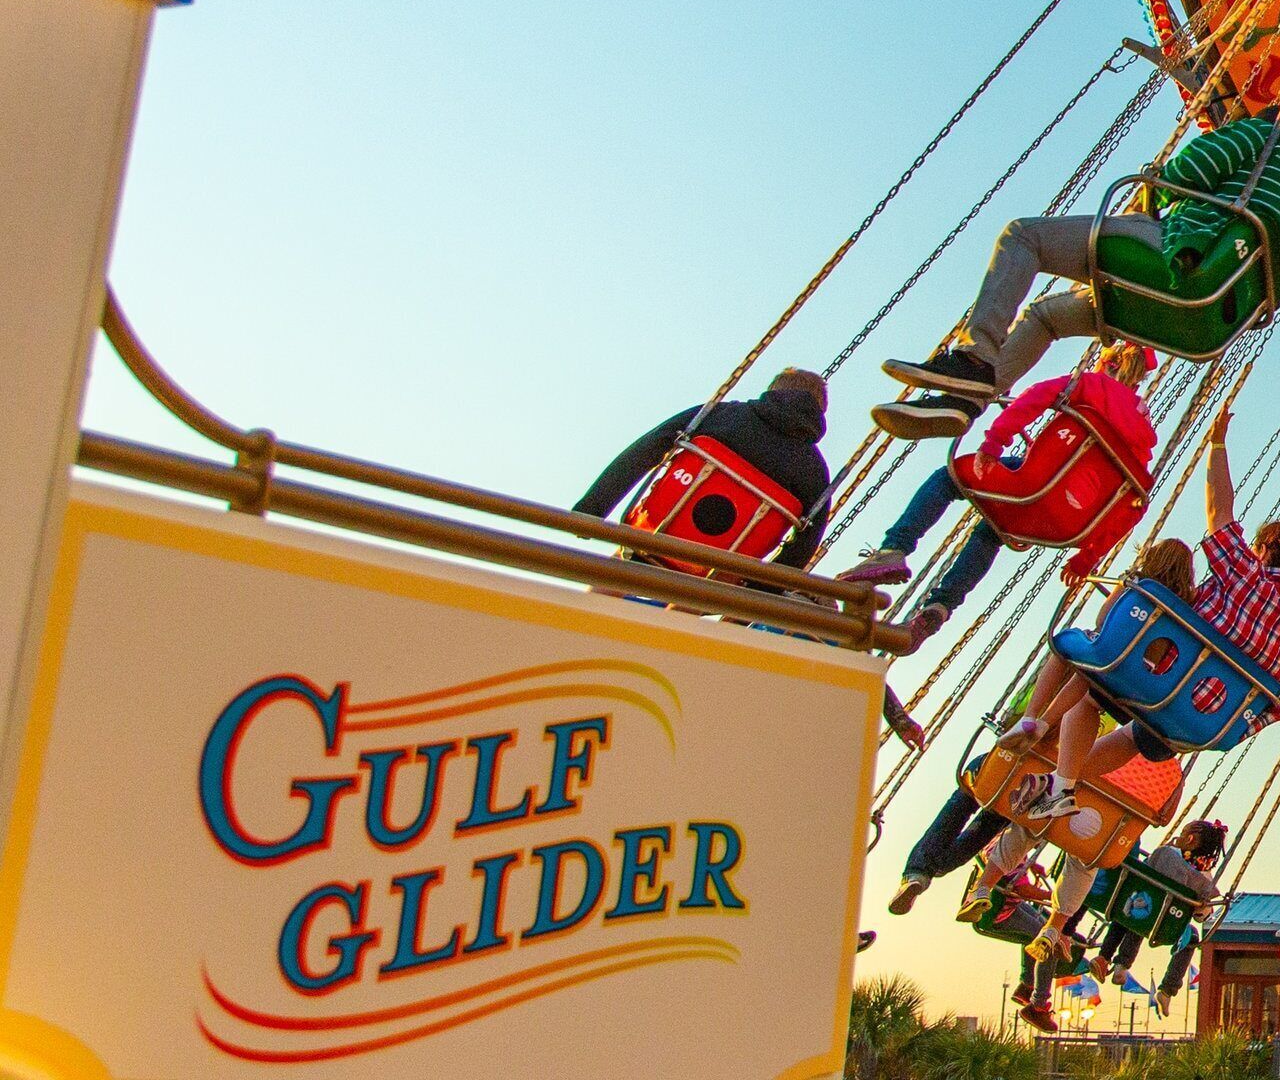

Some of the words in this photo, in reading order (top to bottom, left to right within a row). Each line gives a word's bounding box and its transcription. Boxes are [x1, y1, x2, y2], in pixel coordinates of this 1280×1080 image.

[1235, 239, 1249, 260] 43
[1058, 428, 1076, 445] 41
[673, 469, 693, 486] 40
[1130, 606, 1148, 622] 39
[199, 673, 613, 867] GULF
[1118, 836, 1132, 848] 61
[278, 820, 750, 997] GLIDER
[1169, 906, 1183, 918] 60
